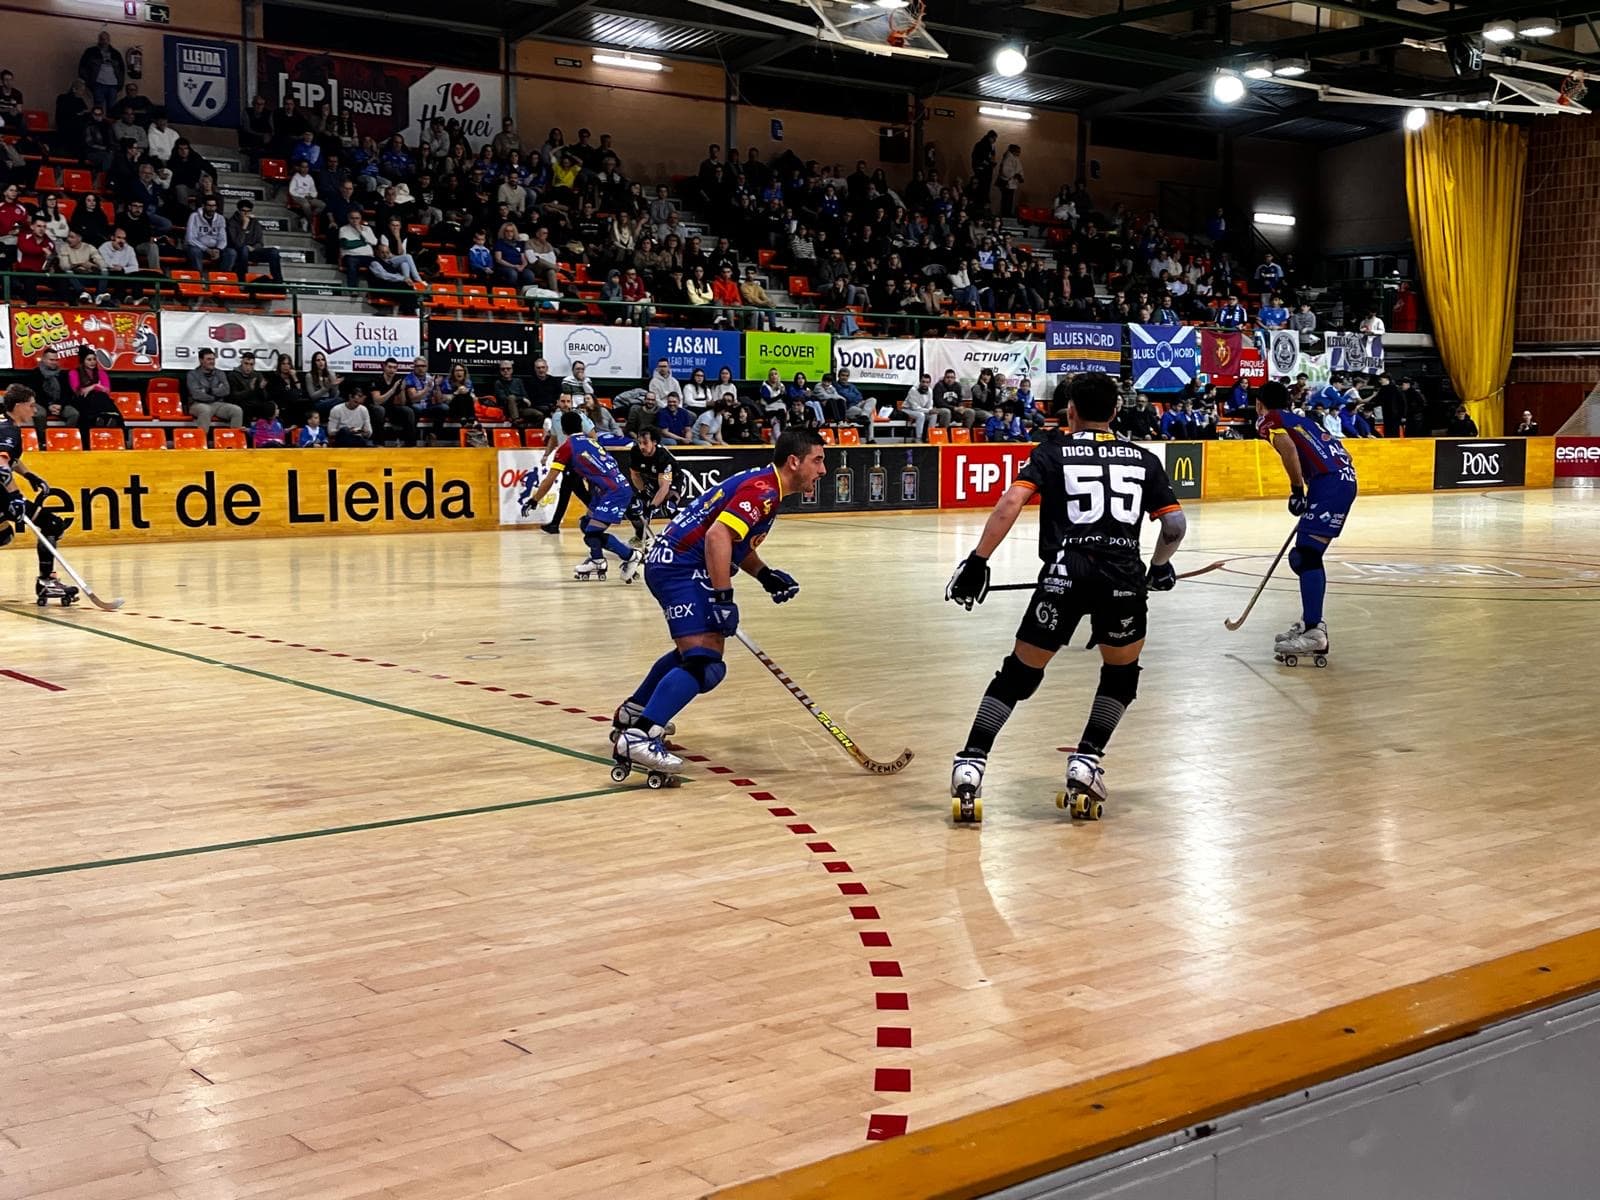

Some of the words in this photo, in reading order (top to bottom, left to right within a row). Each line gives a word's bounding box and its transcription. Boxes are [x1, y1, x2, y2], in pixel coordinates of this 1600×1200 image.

[182, 49, 221, 66] LLEIDA
[343, 88, 393, 102] FINQUES
[344, 100, 393, 117] PRATS
[416, 104, 493, 139] Huei
[354, 321, 398, 341] fusta
[435, 338, 528, 355] MYEPUBLI
[568, 342, 605, 352] BRAICON
[1053, 332, 1084, 346] BLUES
[1085, 333, 1115, 347] NORD
[353, 342, 415, 358] ambient
[759, 345, 815, 358] R-COVER
[963, 352, 1021, 362] ACTIVA'T
[1132, 347, 1156, 360] BLUES
[1174, 348, 1195, 359] NORD
[1240, 359, 1265, 368] FINQUES
[1240, 368, 1265, 378] PRATS
[1062, 445, 1095, 458] NICO
[1099, 446, 1143, 460] OJEDA
[1461, 451, 1500, 475] PONS
[175, 470, 261, 528] de
[287, 467, 475, 524] Lleida
[1063, 464, 1147, 525] 55
[862, 759, 903, 773] AZEMAD
